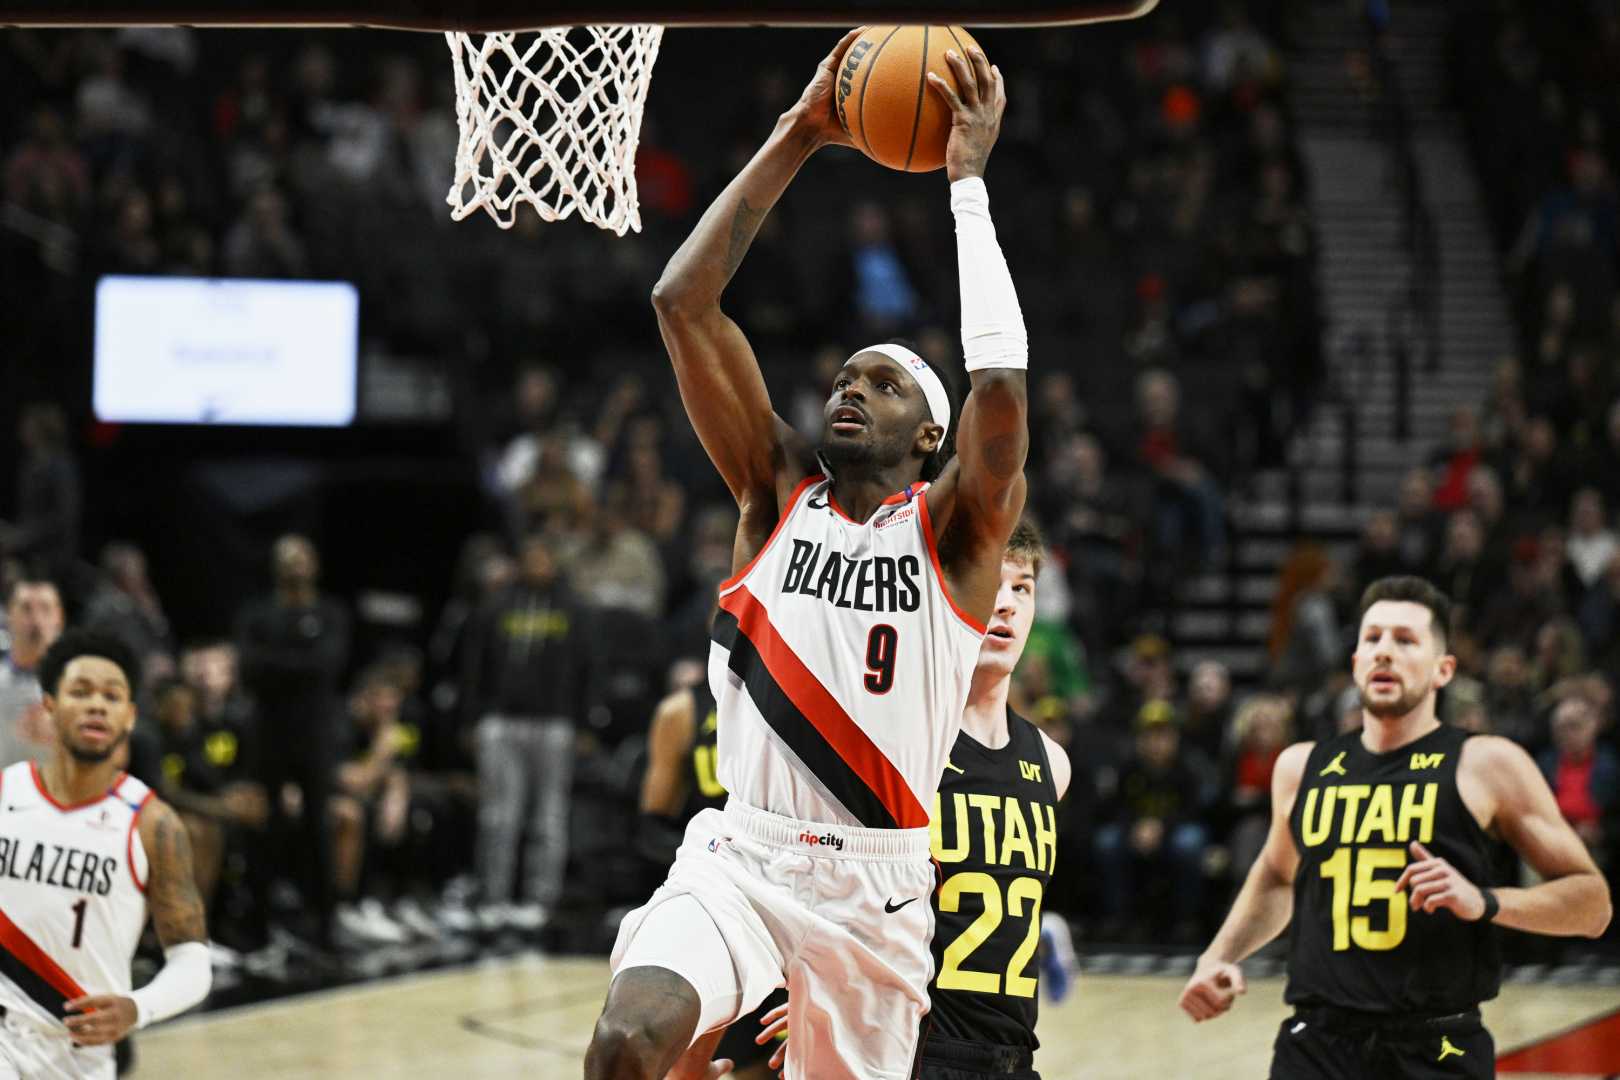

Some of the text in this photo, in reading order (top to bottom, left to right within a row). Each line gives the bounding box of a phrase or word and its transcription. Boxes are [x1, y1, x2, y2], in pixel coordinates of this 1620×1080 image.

[781, 538, 921, 613] BLAZERS
[863, 623, 898, 696] 9
[800, 829, 844, 851] ripcity
[929, 792, 1057, 876] UTAH
[1301, 782, 1438, 847] UTAH
[71, 898, 88, 949] 1
[936, 871, 1043, 998] 22
[1320, 847, 1407, 951] 15
